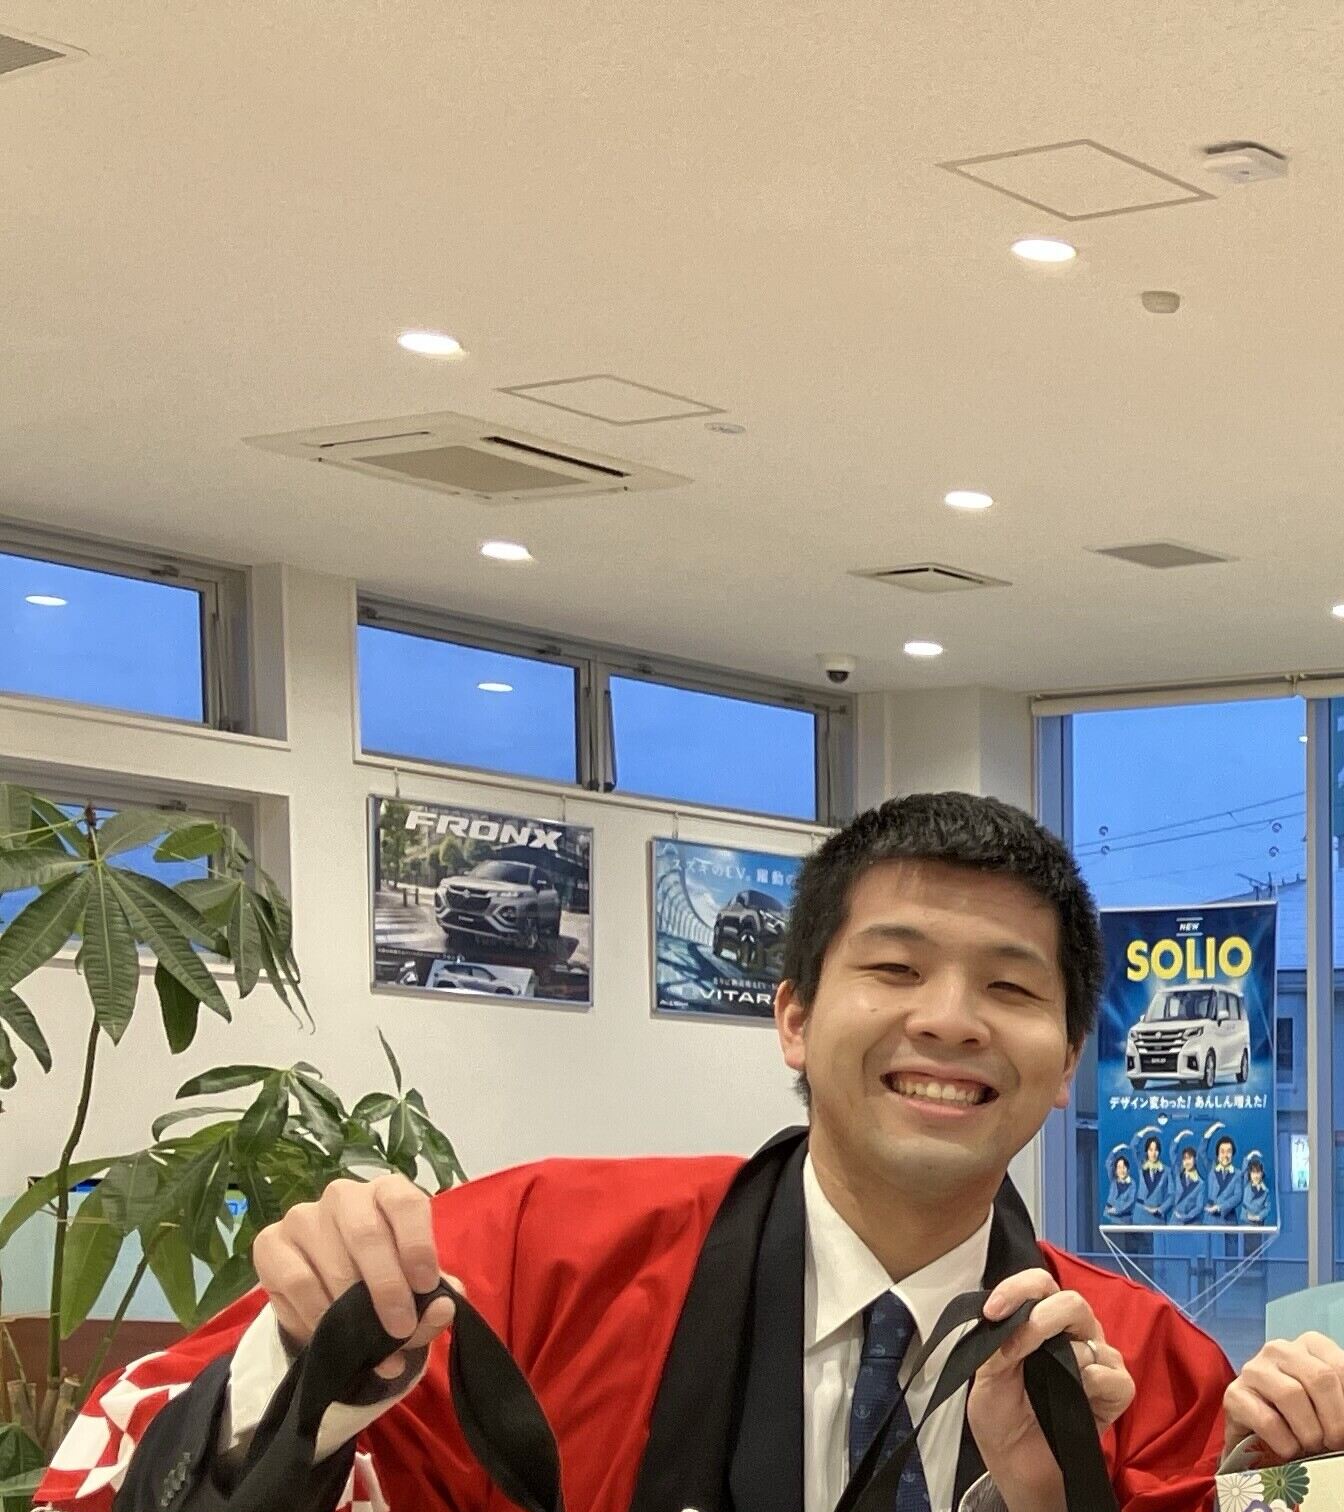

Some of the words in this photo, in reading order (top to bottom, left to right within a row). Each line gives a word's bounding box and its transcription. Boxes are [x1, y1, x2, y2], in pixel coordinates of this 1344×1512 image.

[404, 810, 563, 851] FRONX
[1179, 922, 1200, 932] NEW
[1126, 935, 1253, 983] SOLIO
[700, 988, 777, 1006] VITAR
